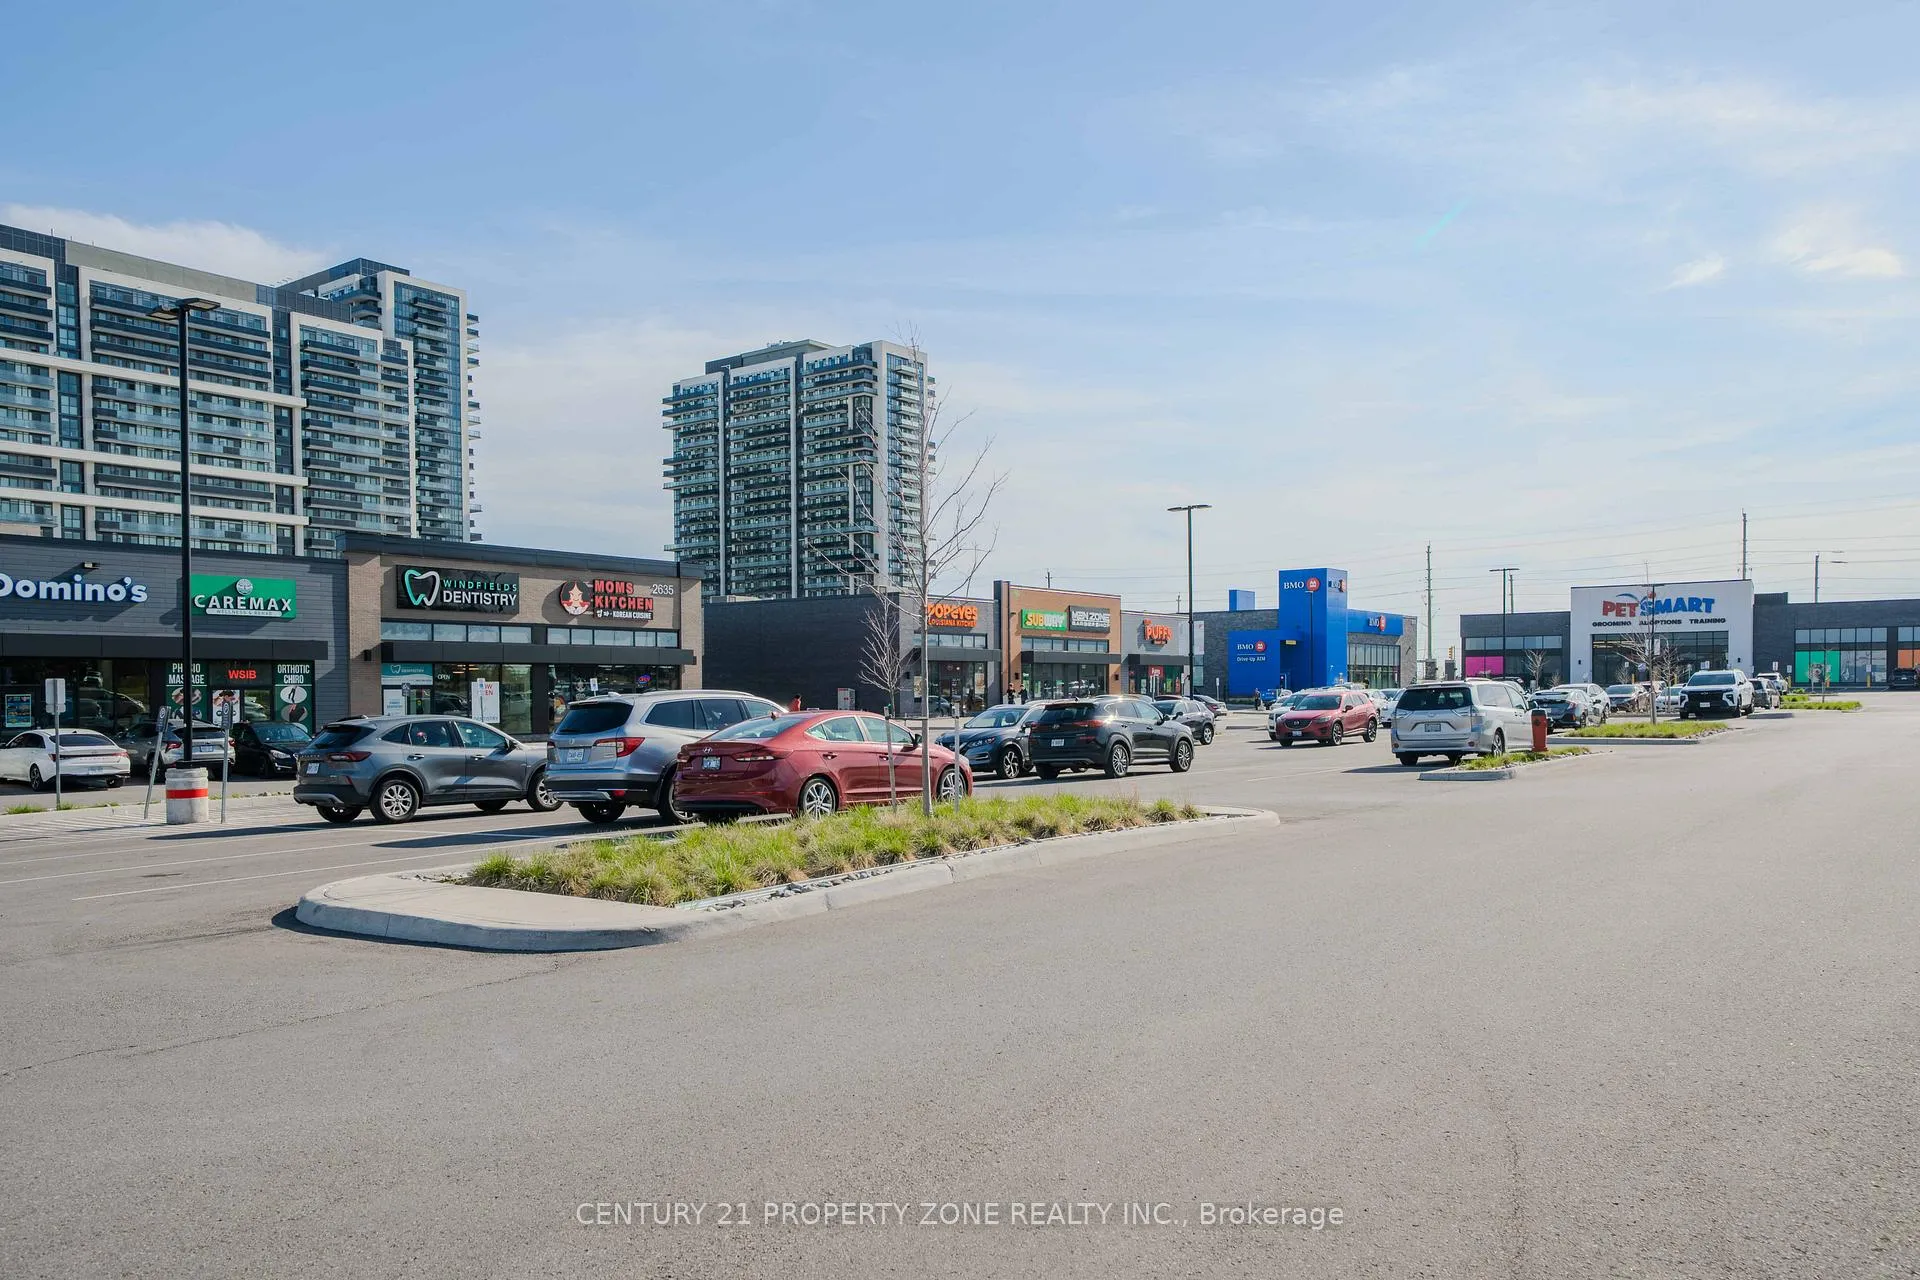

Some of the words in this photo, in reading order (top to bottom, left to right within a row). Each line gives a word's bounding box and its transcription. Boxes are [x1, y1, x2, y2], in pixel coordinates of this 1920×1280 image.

[443, 580, 517, 592] WINDFIELDS
[594, 580, 634, 594] MOMS
[652, 584, 674, 595] 2635
[1284, 581, 1304, 589] BMO
[194, 595, 292, 611] CAREMAX
[443, 591, 517, 606] DENTISTRY
[594, 595, 653, 610] KITCHEN
[1026, 613, 1065, 627] SUBWAY
[172, 663, 200, 673] PHIO
[277, 664, 310, 674] ORTHOTIC
[168, 674, 205, 684] MASAGE
[228, 670, 257, 679] WSIB
[283, 674, 304, 684] CHIRO
